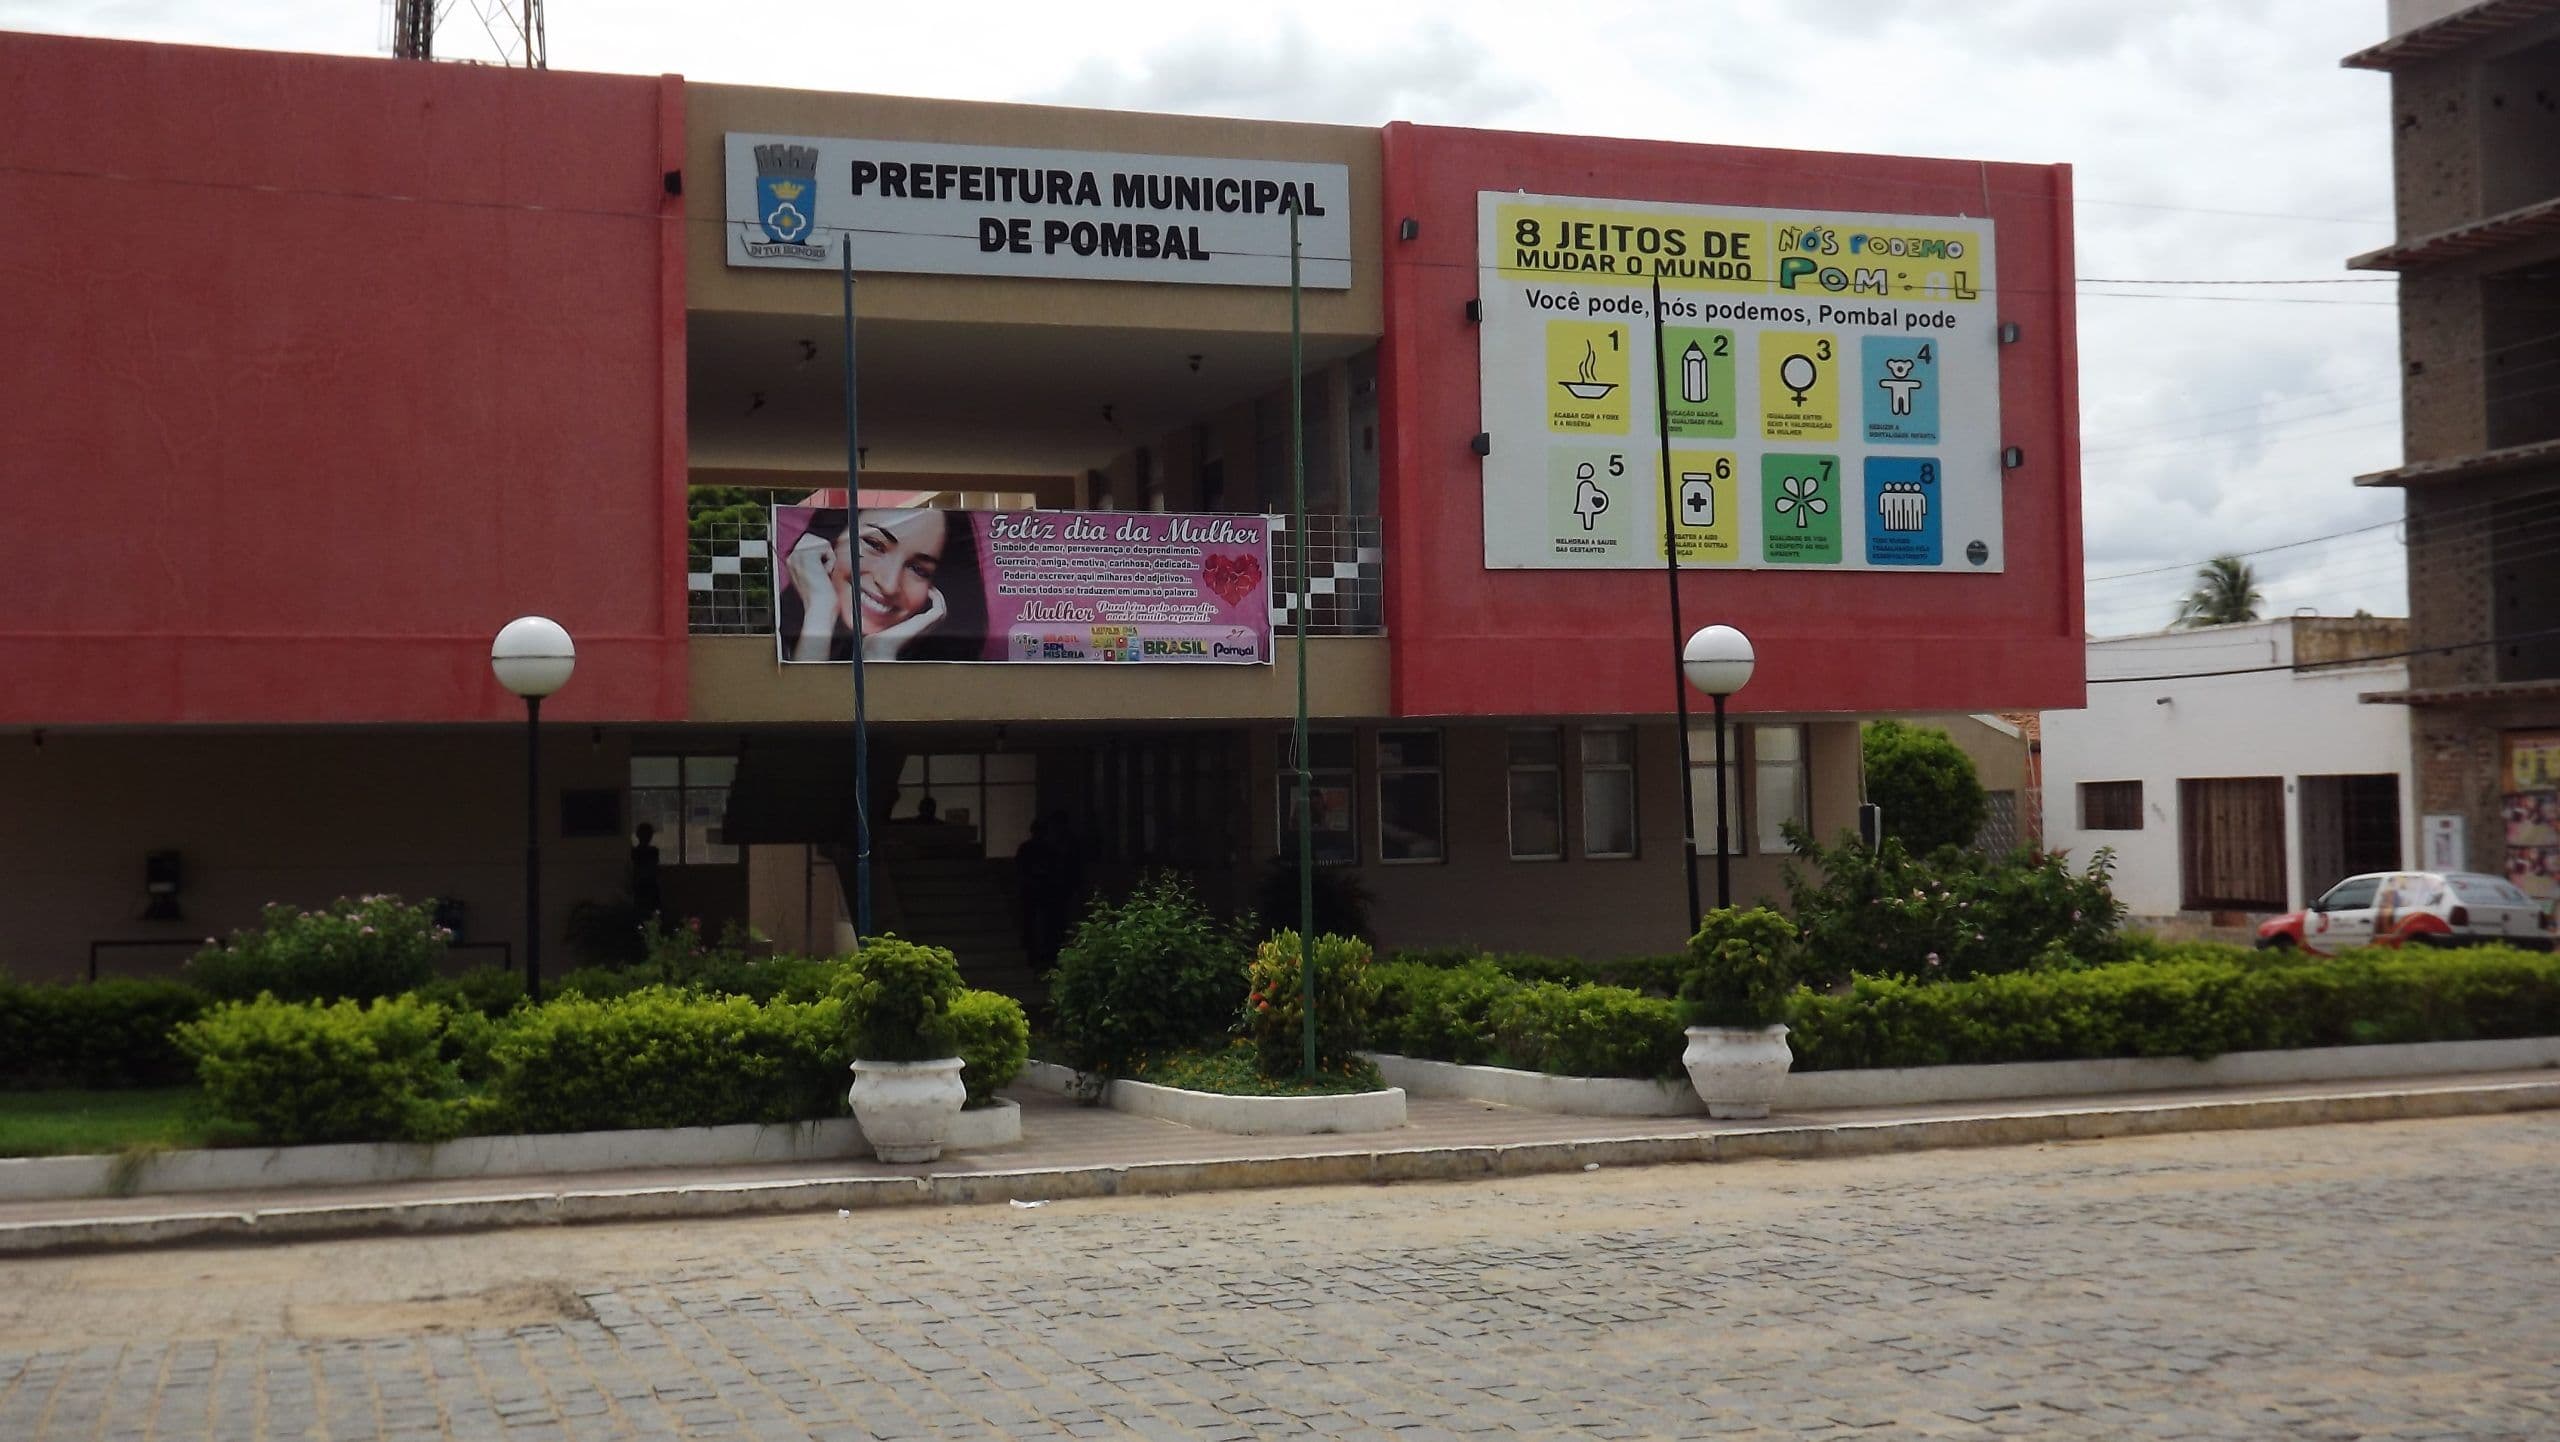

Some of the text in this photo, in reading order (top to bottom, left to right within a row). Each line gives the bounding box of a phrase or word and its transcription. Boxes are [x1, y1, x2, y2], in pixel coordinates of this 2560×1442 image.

[851, 160, 1325, 216] PREFEITURA MUNICIPAL
[979, 217, 1211, 261] DE POMBAL
[1515, 218, 1751, 260] 8 JEITOS DE
[1779, 226, 1840, 255] NÓS
[1516, 248, 1752, 281] MUDAR O MUNDO
[1525, 288, 1956, 331] Você pode, nós podemos, Pombal pode
[1608, 330, 1619, 351] 1
[1713, 335, 1729, 357] 2
[1816, 339, 1832, 361] 3
[1917, 344, 1932, 365] 4
[1608, 454, 1625, 476] 5
[1715, 458, 1731, 480] 6
[1819, 461, 1833, 482] 7
[1919, 463, 1935, 485] 8
[989, 514, 1260, 544] Feliz dia da Mulher
[999, 586, 1017, 594] Mas
[1017, 600, 1095, 620] Mulher
[1143, 641, 1208, 655] BRASIL
